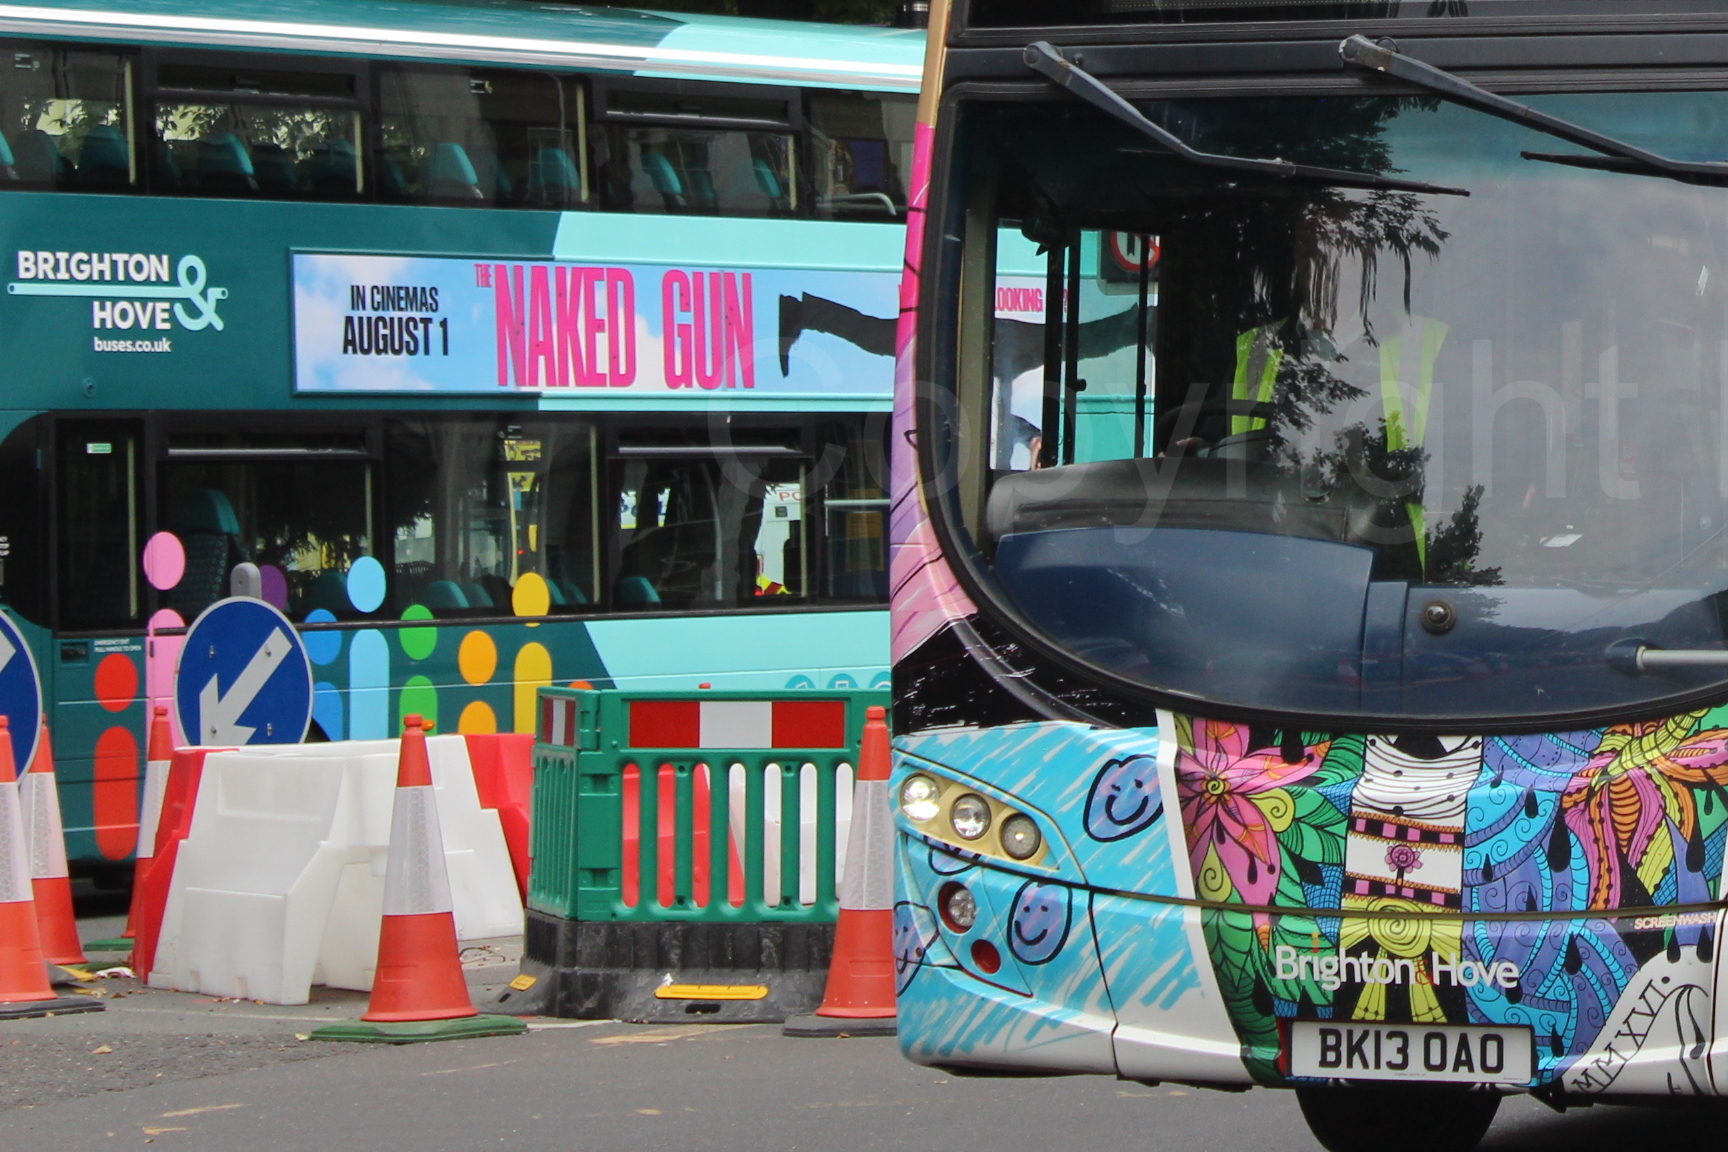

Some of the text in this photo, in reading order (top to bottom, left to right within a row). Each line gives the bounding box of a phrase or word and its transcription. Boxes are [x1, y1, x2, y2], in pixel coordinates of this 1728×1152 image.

[17, 250, 170, 282] BRIGHTON
[350, 284, 439, 314] IN CINEMAS
[994, 287, 1044, 313] OOKING
[92, 301, 172, 330] HOVE
[474, 263, 756, 391] THE NAKED GUN
[93, 336, 172, 353] buses.co.uk
[342, 315, 449, 357] AUGUST 1
[1633, 911, 1718, 931] SCREENWASH
[1275, 944, 1416, 992] Brighton
[1431, 951, 1520, 990] Hove
[1317, 1027, 1505, 1075] BK13 OAO
